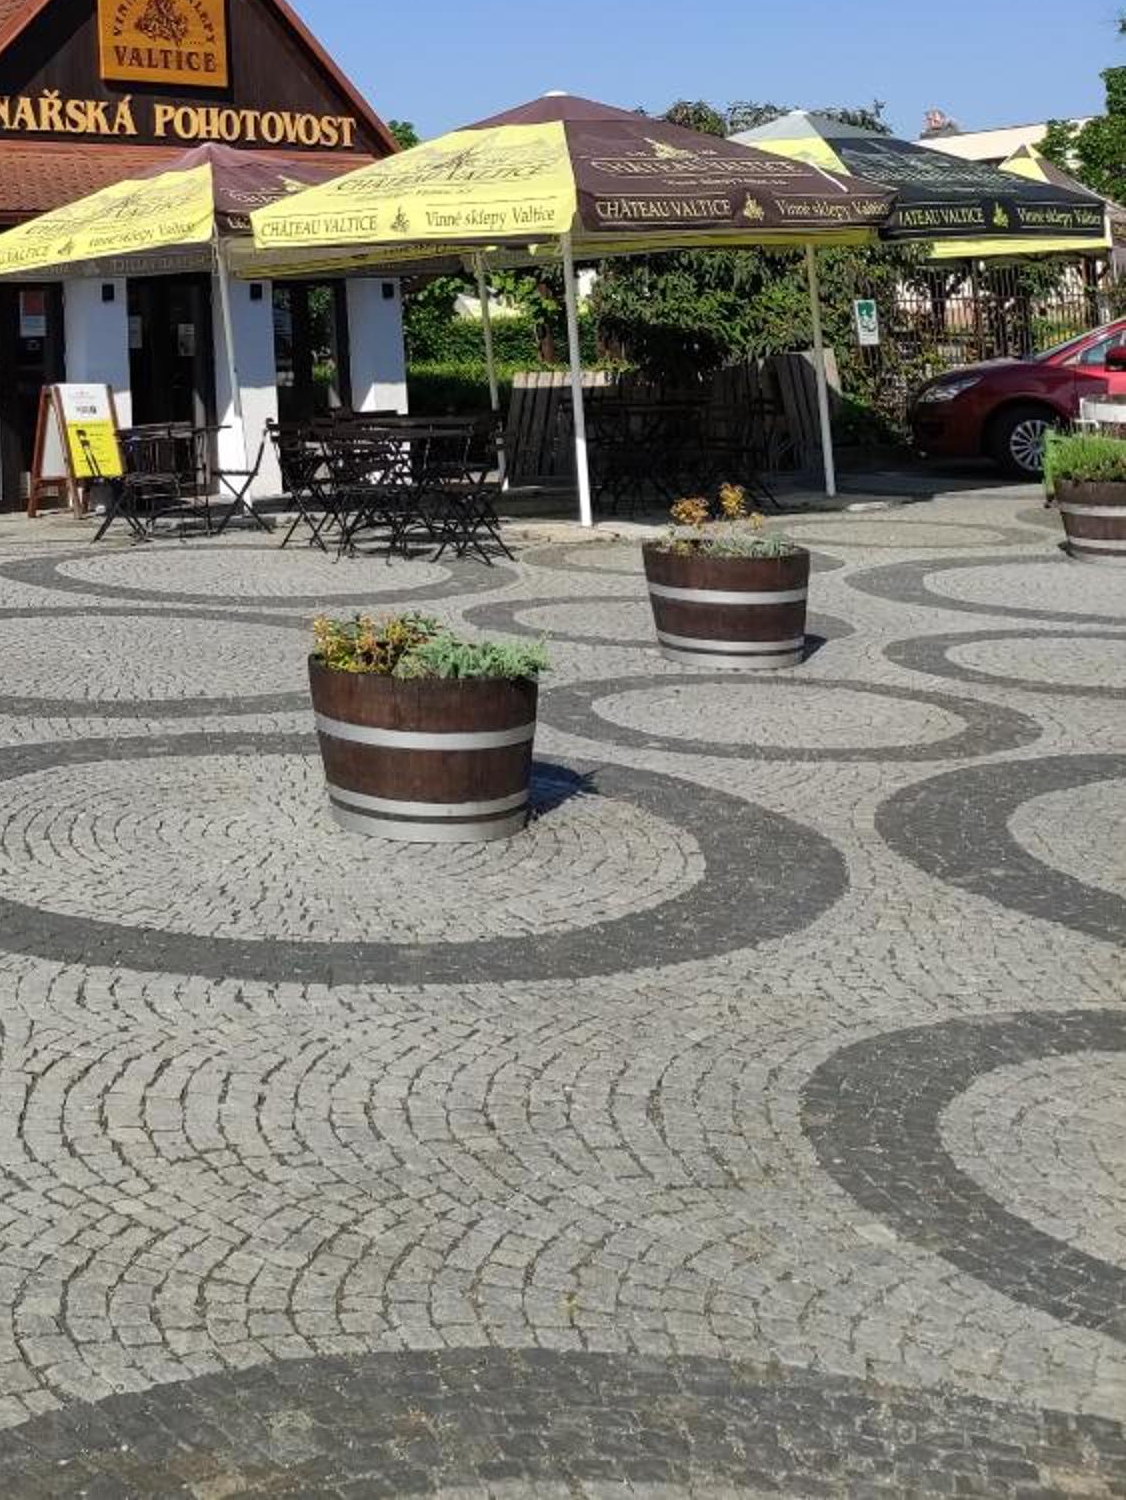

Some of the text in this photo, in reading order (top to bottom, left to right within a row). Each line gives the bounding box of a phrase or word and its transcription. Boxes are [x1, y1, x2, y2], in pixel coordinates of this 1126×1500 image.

[113, 45, 218, 73] VALTICE
[153, 103, 356, 147] POHOTOVOST
[425, 204, 555, 231] Vinné sklepy Valtice
[596, 198, 731, 219] CHÂTEAU VALTICE
[323, 215, 377, 233] VALTICE
